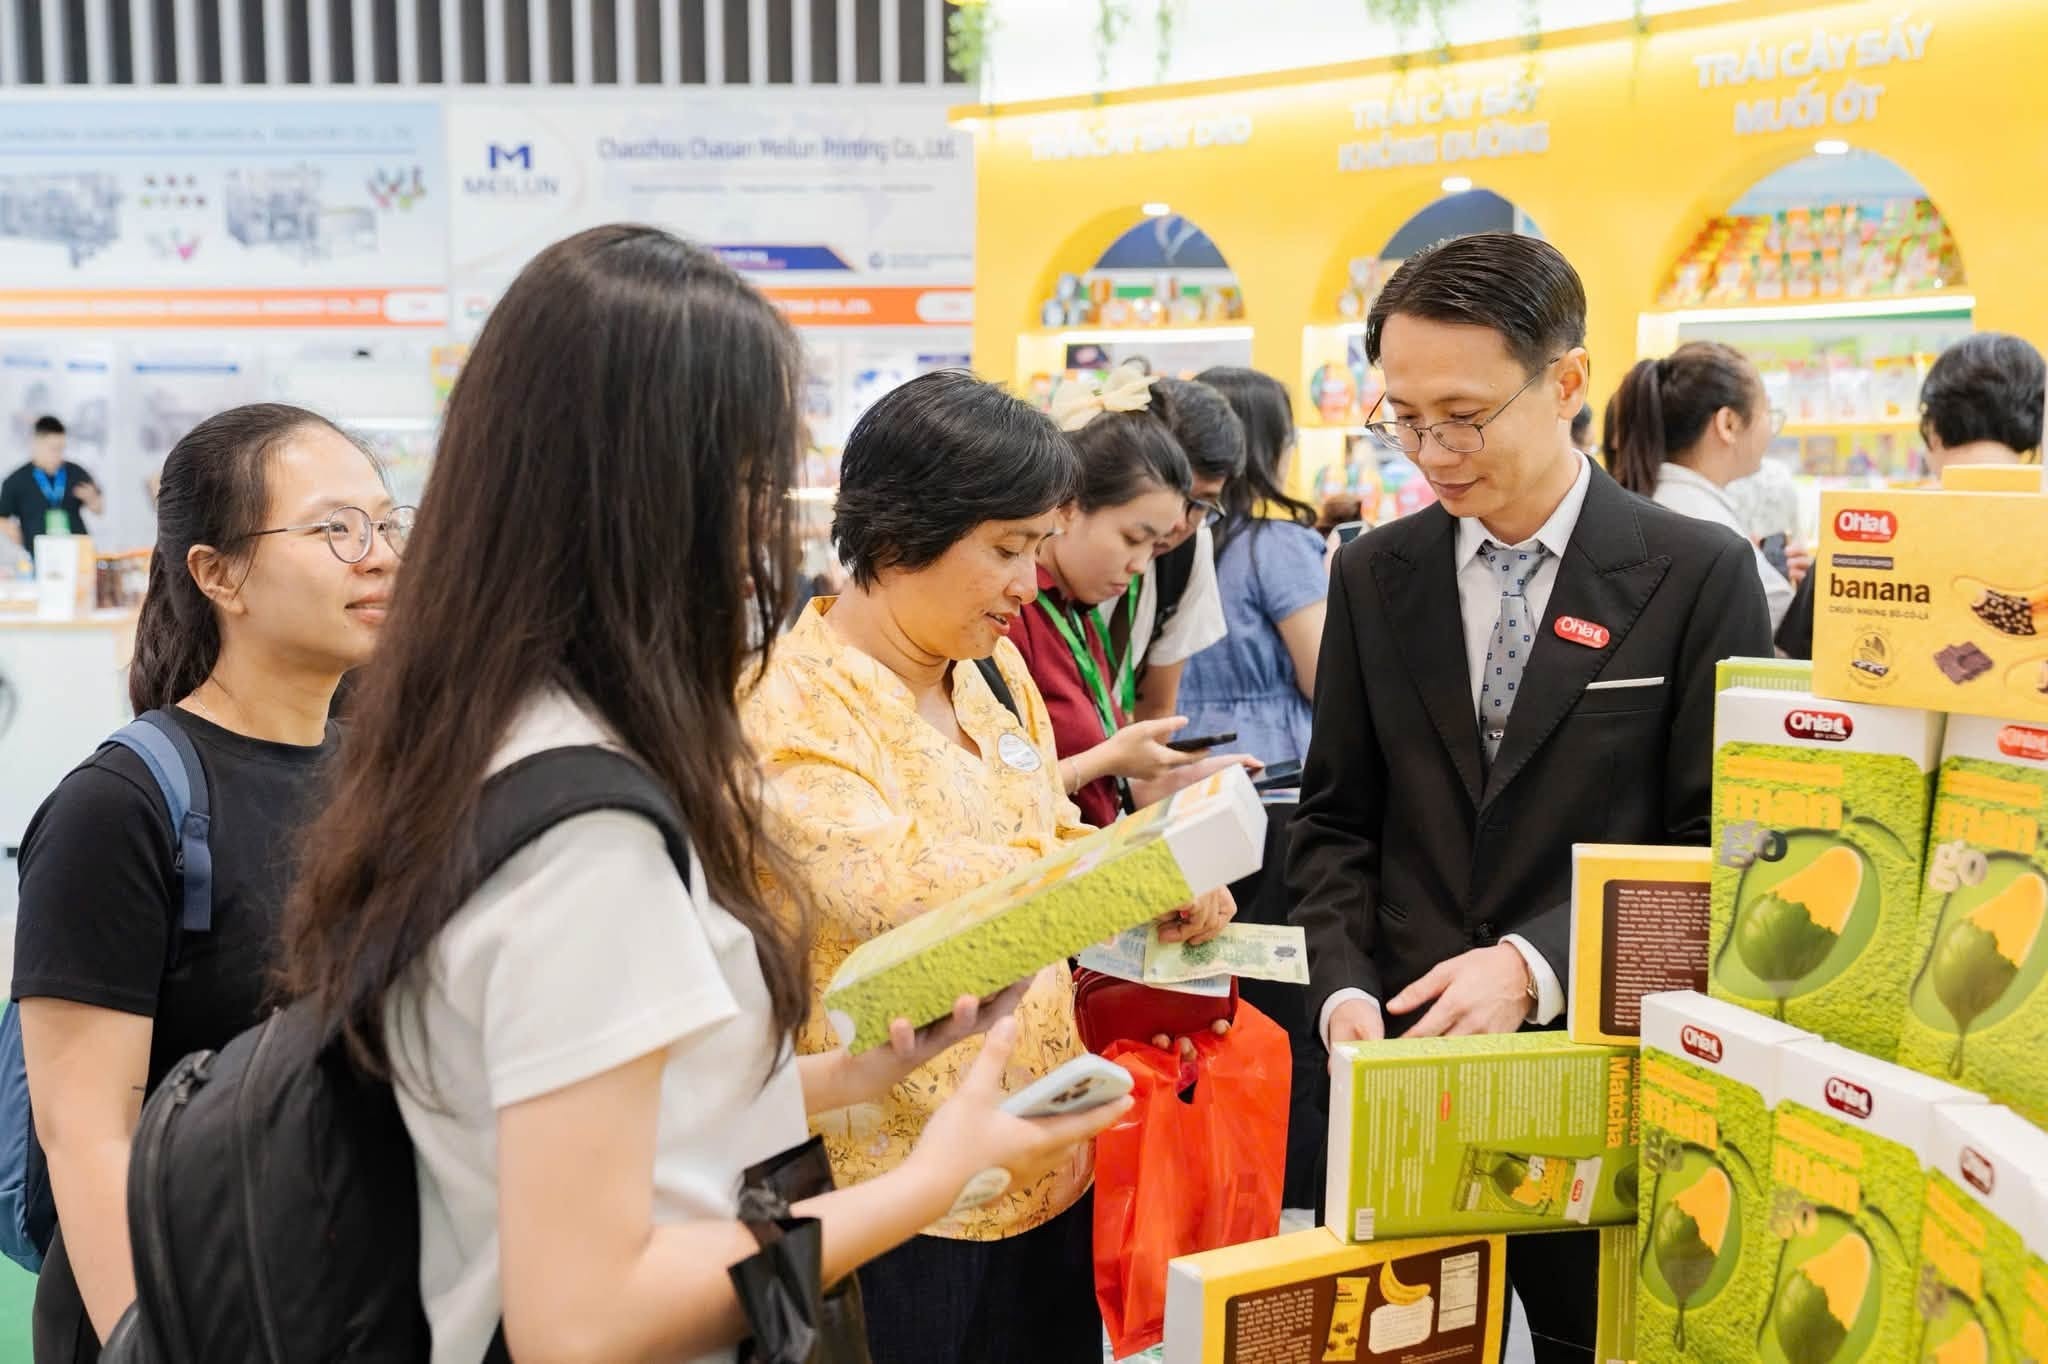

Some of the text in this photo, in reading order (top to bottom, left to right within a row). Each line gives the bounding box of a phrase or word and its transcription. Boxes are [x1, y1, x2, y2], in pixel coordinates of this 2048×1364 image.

[1694, 11, 1934, 88] TRÁI CÂY SẤY
[1732, 77, 1827, 135] MUỐI
[1829, 573, 1931, 604] banana
[1606, 1056, 1631, 1148] Matcha
